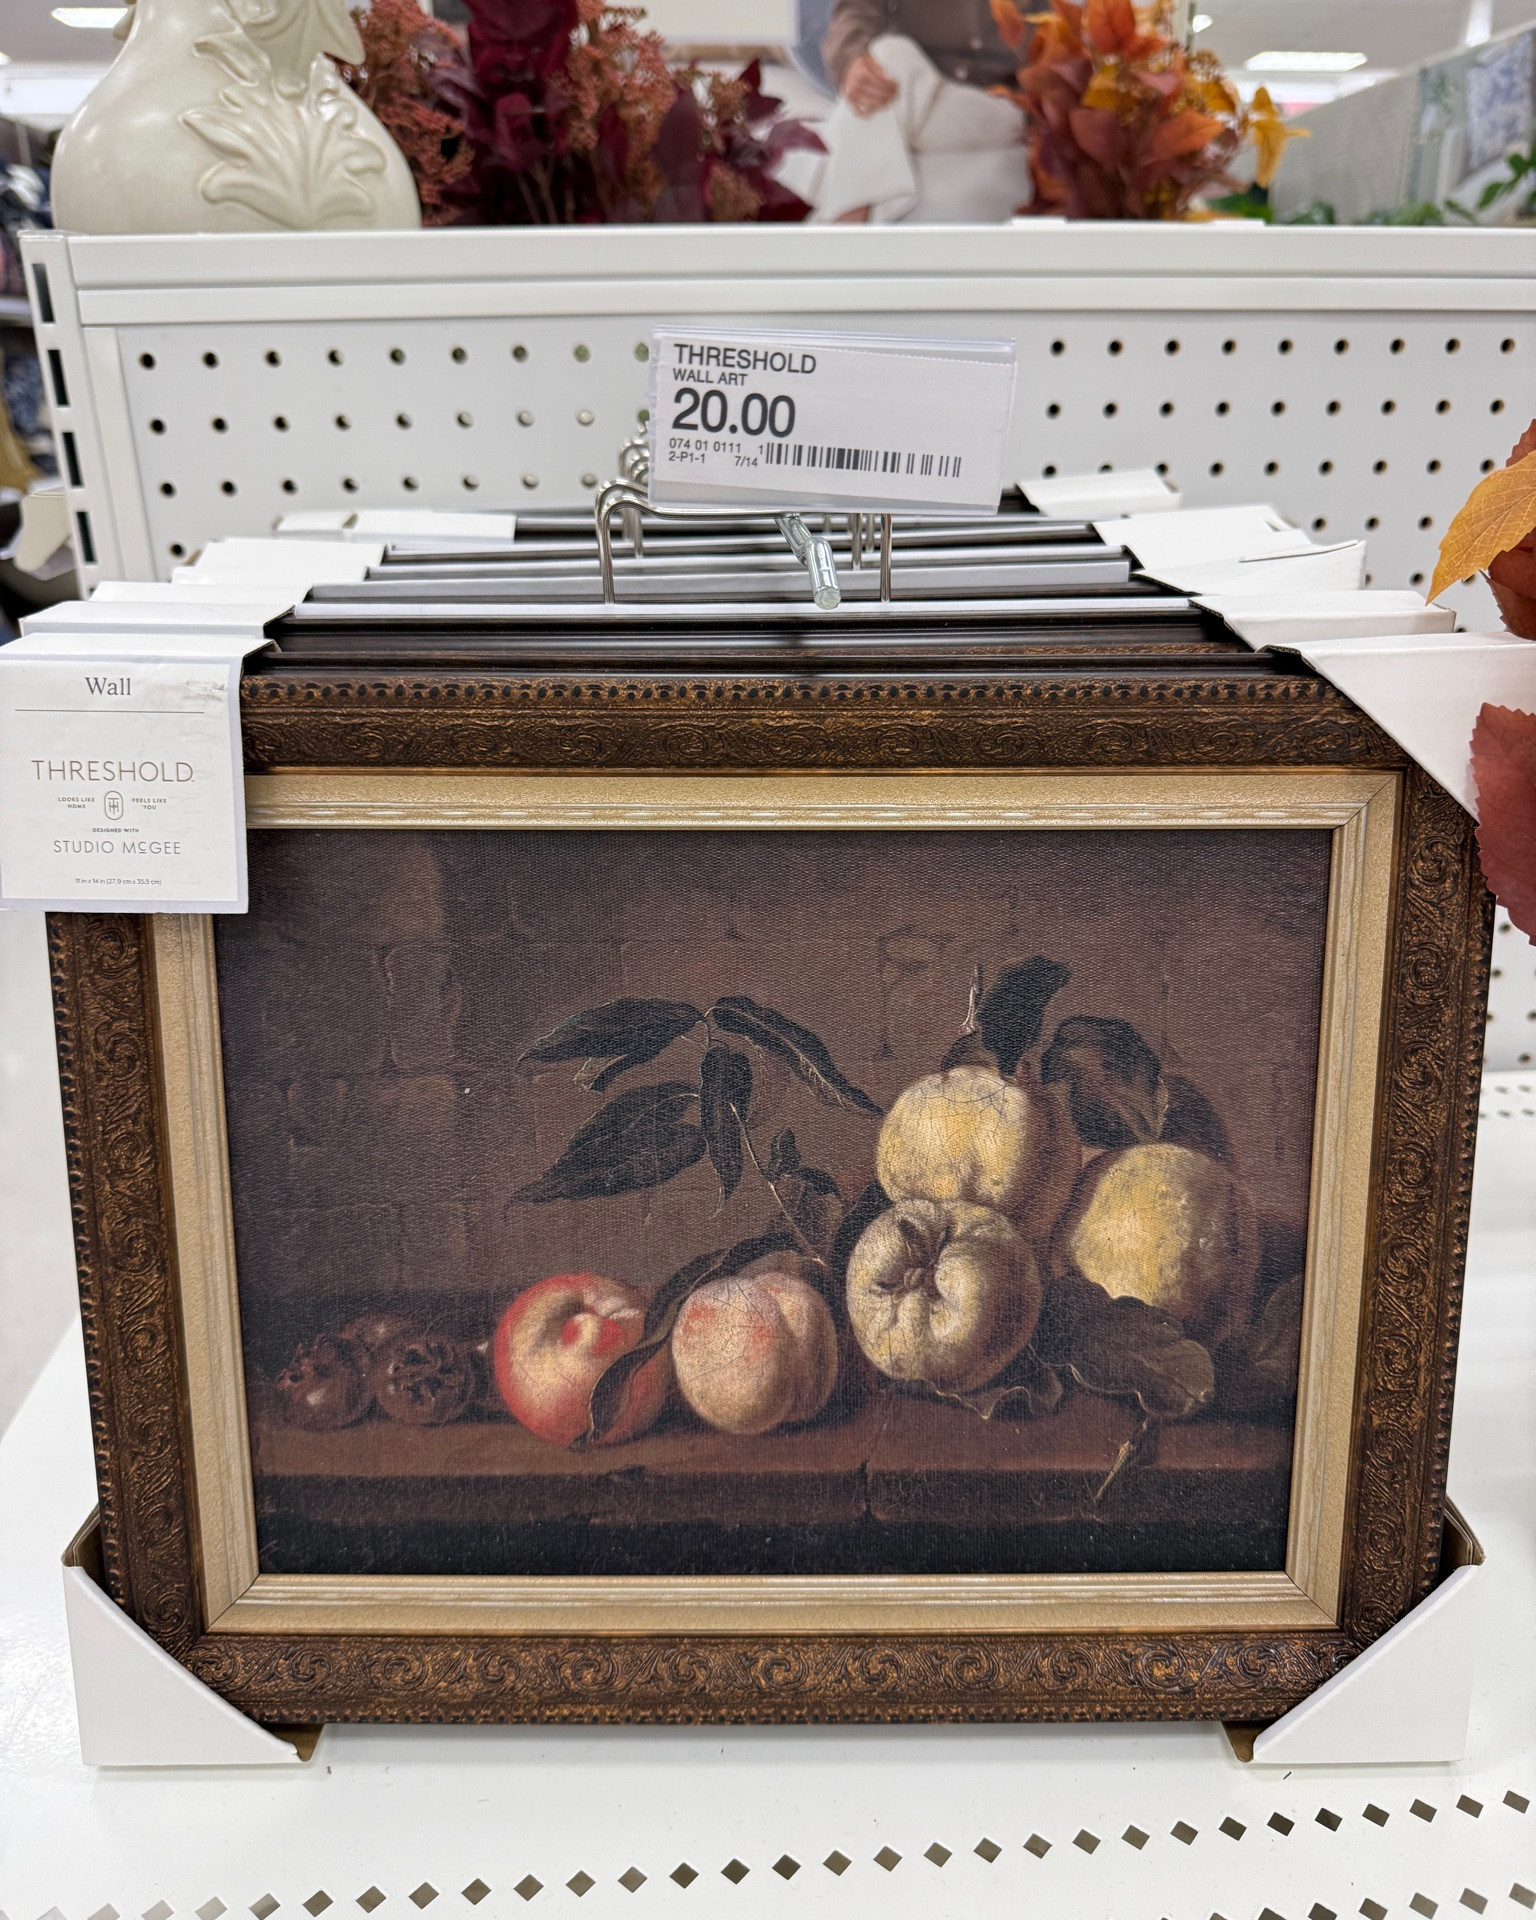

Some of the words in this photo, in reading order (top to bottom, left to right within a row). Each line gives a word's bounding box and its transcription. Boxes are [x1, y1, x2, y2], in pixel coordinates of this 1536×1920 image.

[674, 343, 817, 374] THRESHOLD
[673, 368, 714, 384] WALL
[717, 372, 748, 386] ART
[672, 387, 796, 438] 20.00
[669, 438, 691, 449] 074
[695, 439, 708, 451] 01
[713, 441, 741, 454] 0111
[669, 451, 706, 464] 2-P1-1
[734, 456, 758, 468] 7/14
[85, 677, 131, 696] Wall
[31, 760, 194, 783] THRESHOLD
[54, 840, 115, 853] STUDIO
